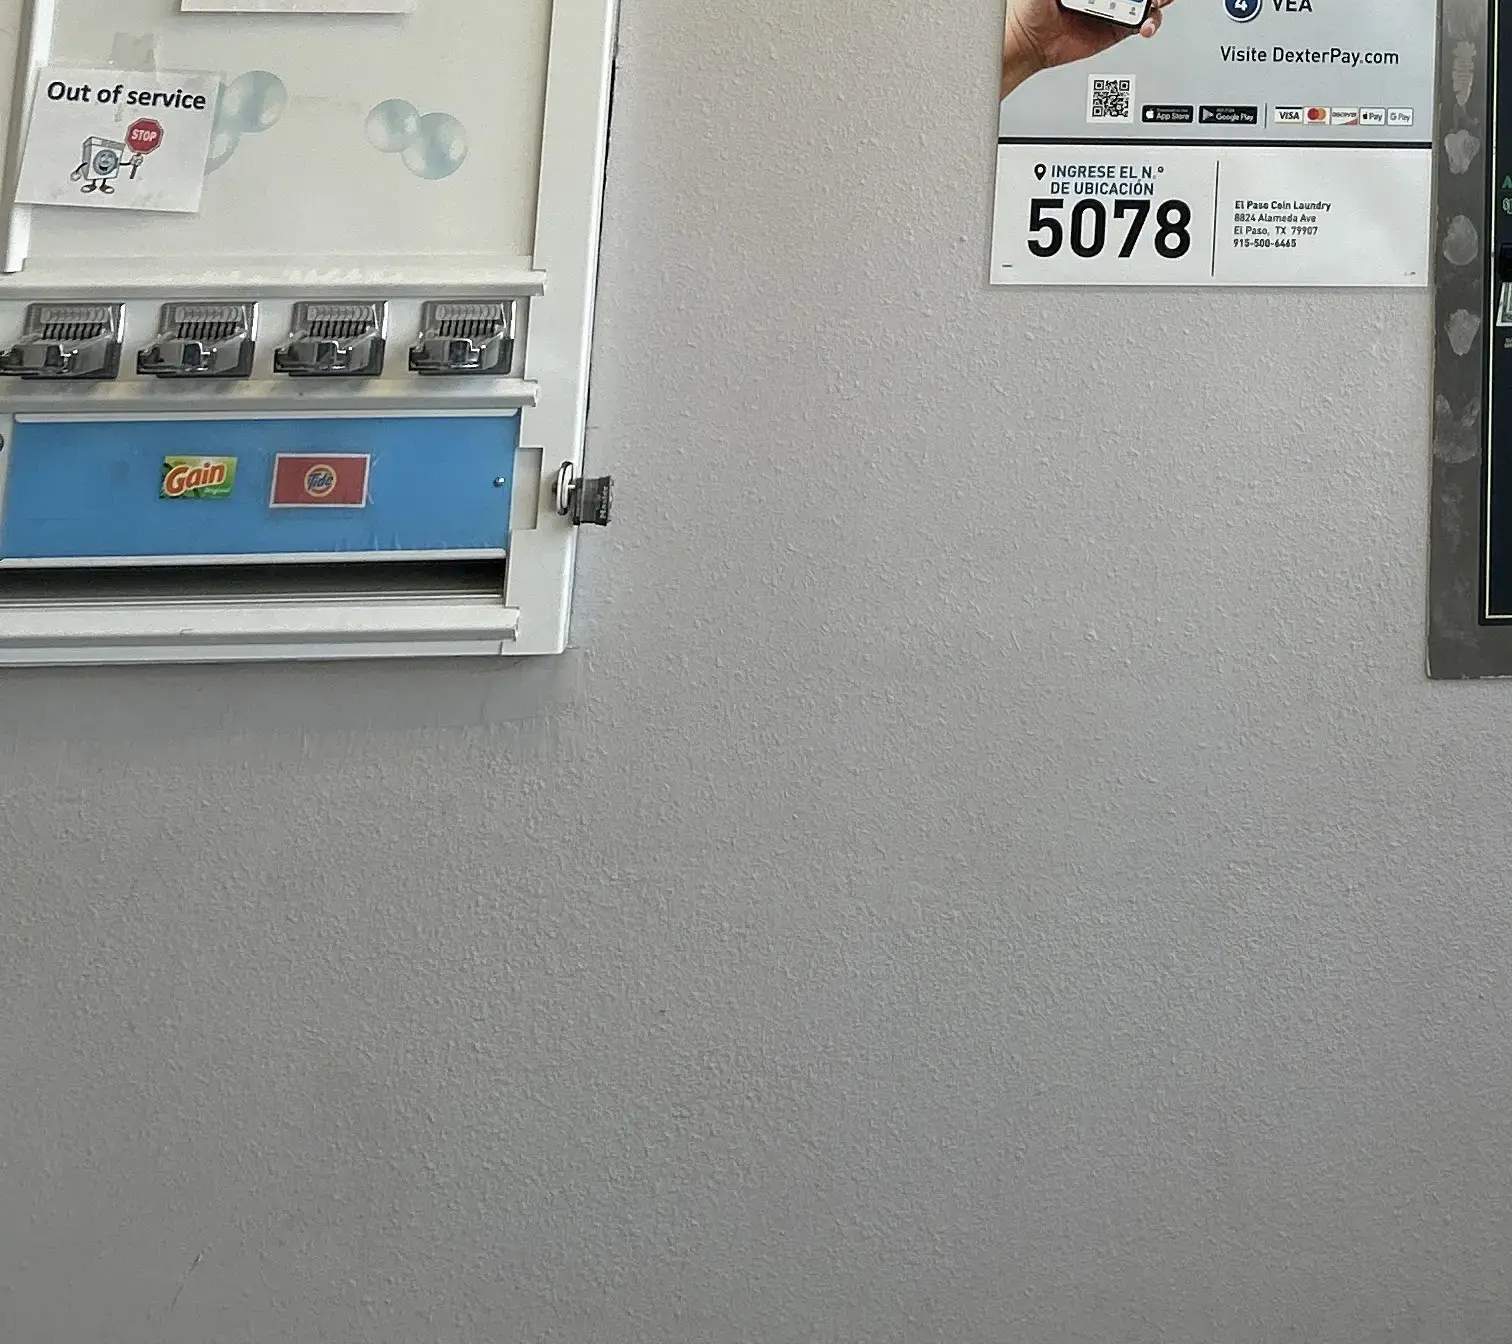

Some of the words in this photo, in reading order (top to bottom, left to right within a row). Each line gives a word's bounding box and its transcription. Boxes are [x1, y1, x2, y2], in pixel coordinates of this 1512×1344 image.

[1220, 46, 1267, 62] Visite
[1273, 47, 1399, 67] DexterPay.com
[48, 81, 91, 102] Out
[97, 85, 124, 104] of
[127, 89, 206, 110] service
[1280, 112, 1299, 120] VISA
[132, 129, 158, 142] STOP
[1051, 165, 1116, 179] INGRESE
[1120, 166, 1137, 179] EL
[1050, 182, 1070, 195] DE
[1074, 180, 1154, 196] UBICACIÓN
[1235, 200, 1244, 210] El
[1247, 200, 1269, 210] Paso
[1271, 200, 1291, 210] Coin
[1294, 200, 1331, 212] Laundry
[1258, 213, 1298, 222] Alameda
[1300, 214, 1317, 222] Ave
[1027, 198, 1191, 258] 5078
[1234, 226, 1243, 235] El
[1246, 226, 1270, 236] Paso,
[1275, 226, 1286, 235] TX
[166, 462, 226, 494] Gain
[306, 472, 333, 490] Tide
